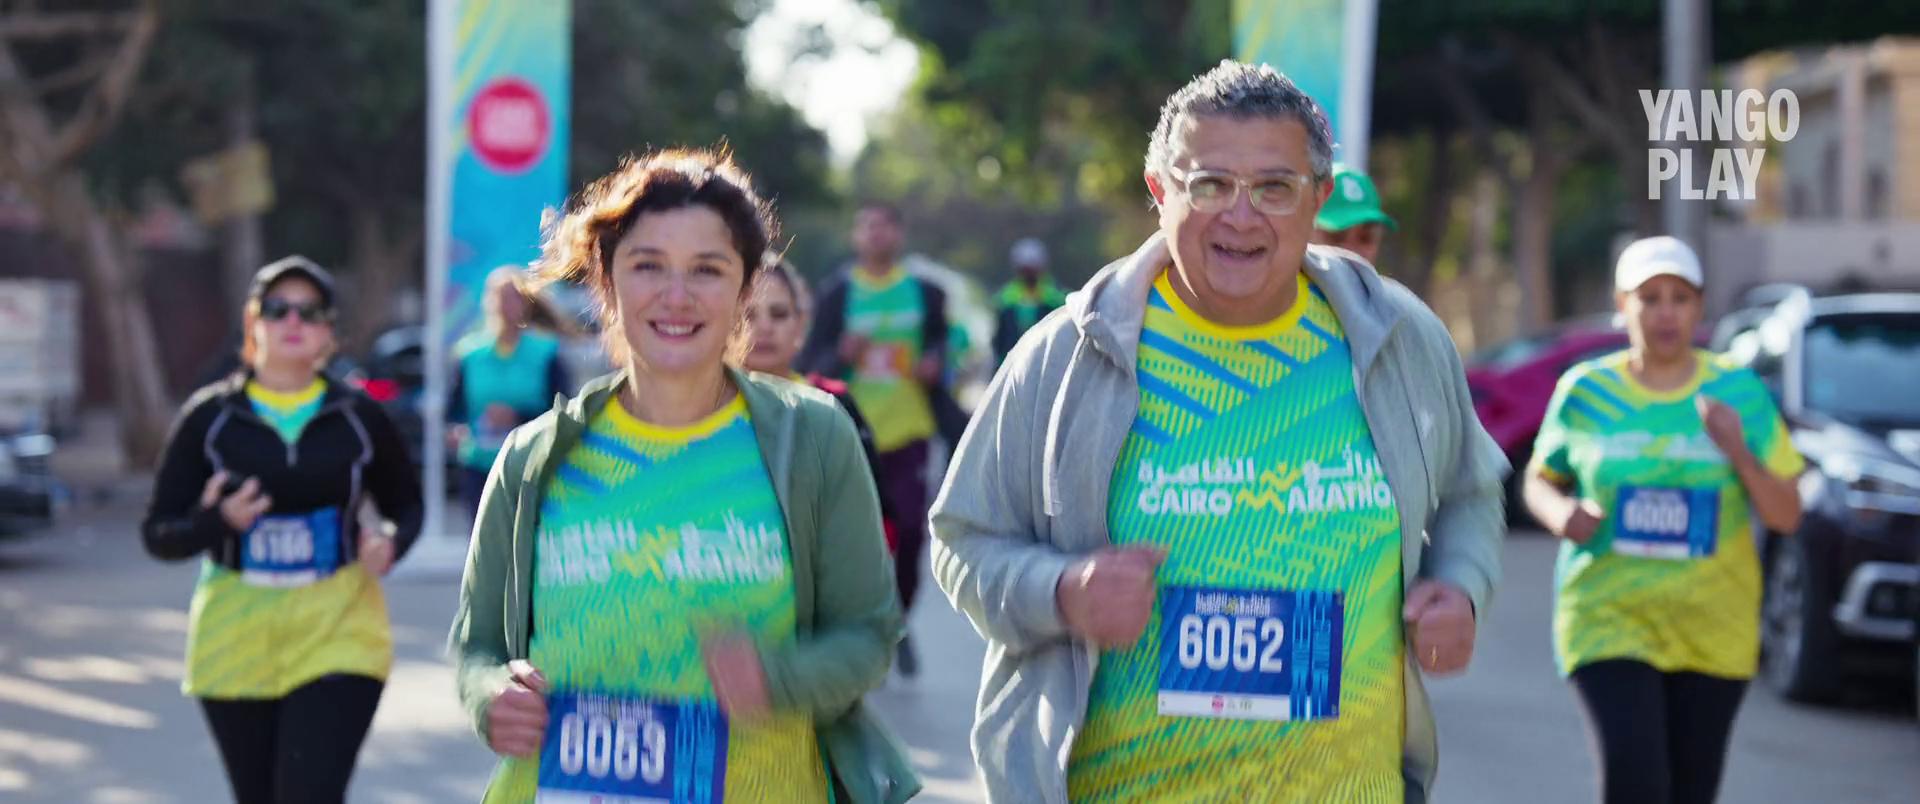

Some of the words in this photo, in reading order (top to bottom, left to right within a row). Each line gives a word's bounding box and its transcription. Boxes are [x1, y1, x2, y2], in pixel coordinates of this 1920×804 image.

[1138, 485, 1233, 516] CAIRO
[1236, 479, 1396, 515] MARATHO
[1179, 614, 1285, 673] 6052
